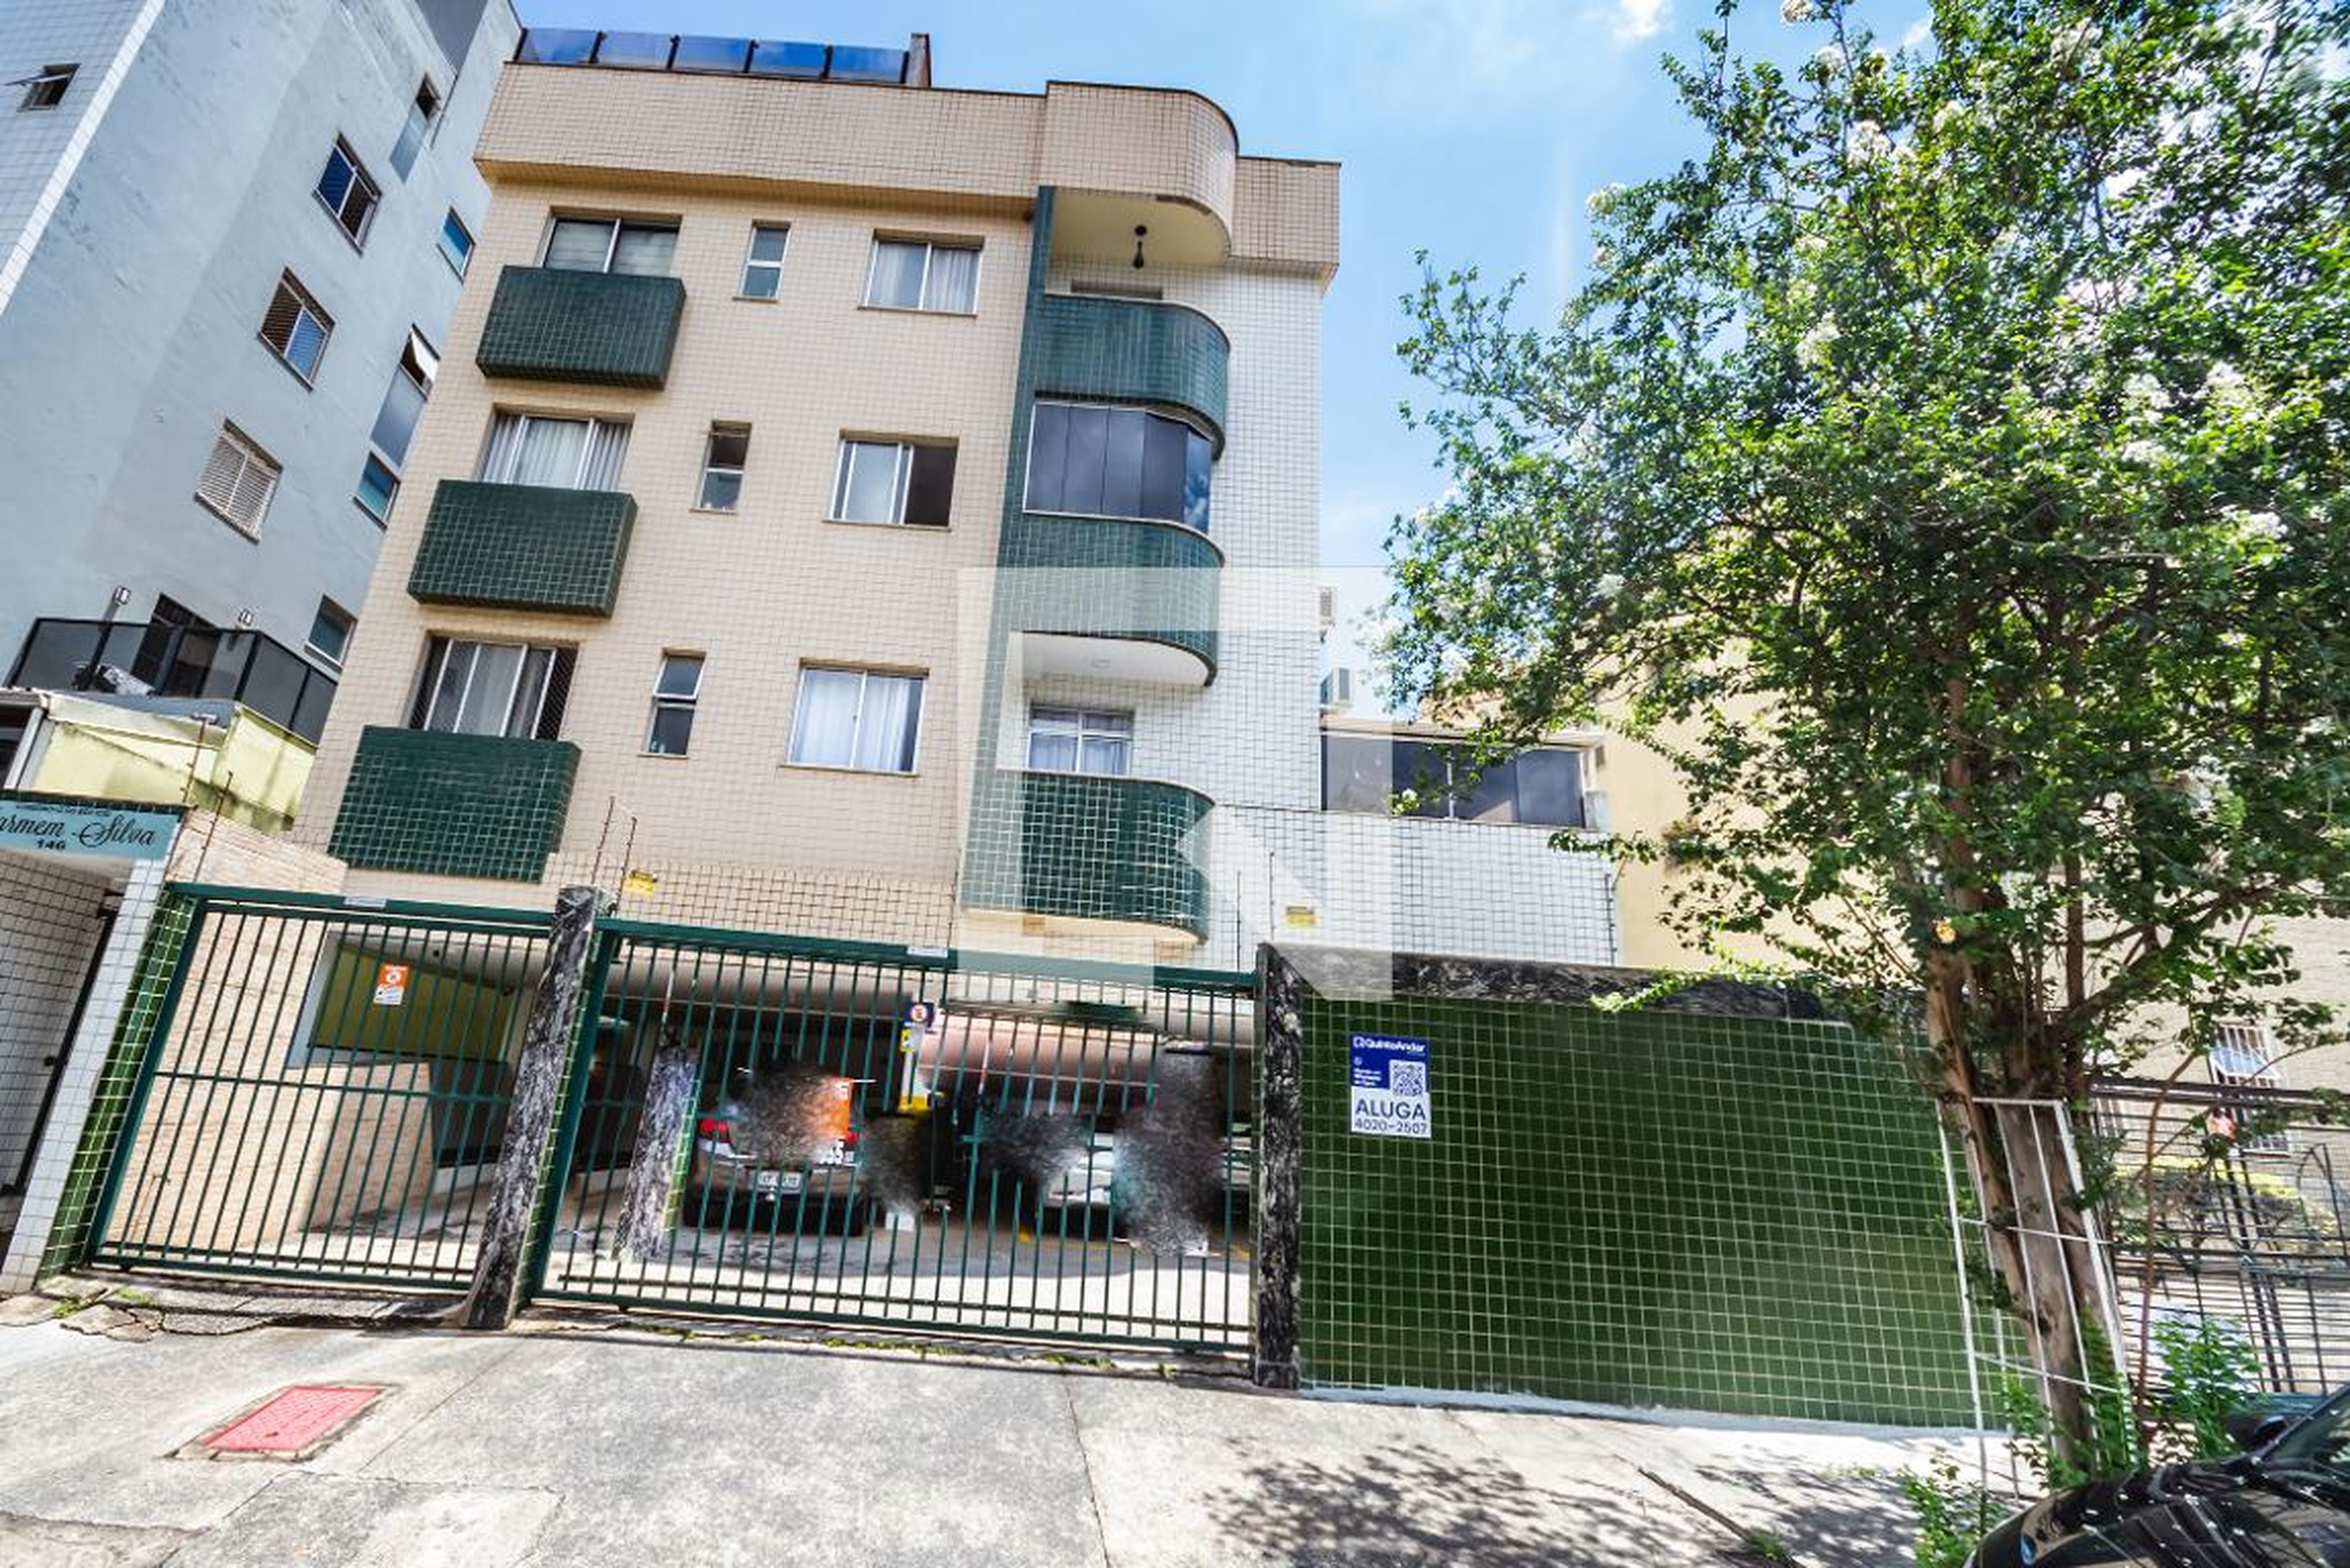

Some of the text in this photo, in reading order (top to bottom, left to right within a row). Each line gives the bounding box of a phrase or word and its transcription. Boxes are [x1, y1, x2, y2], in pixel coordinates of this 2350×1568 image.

[80, 813, 155, 848] Silva
[1356, 1098, 1427, 1121] ALUGA
[1355, 1118, 1427, 1134] 4020-2507
